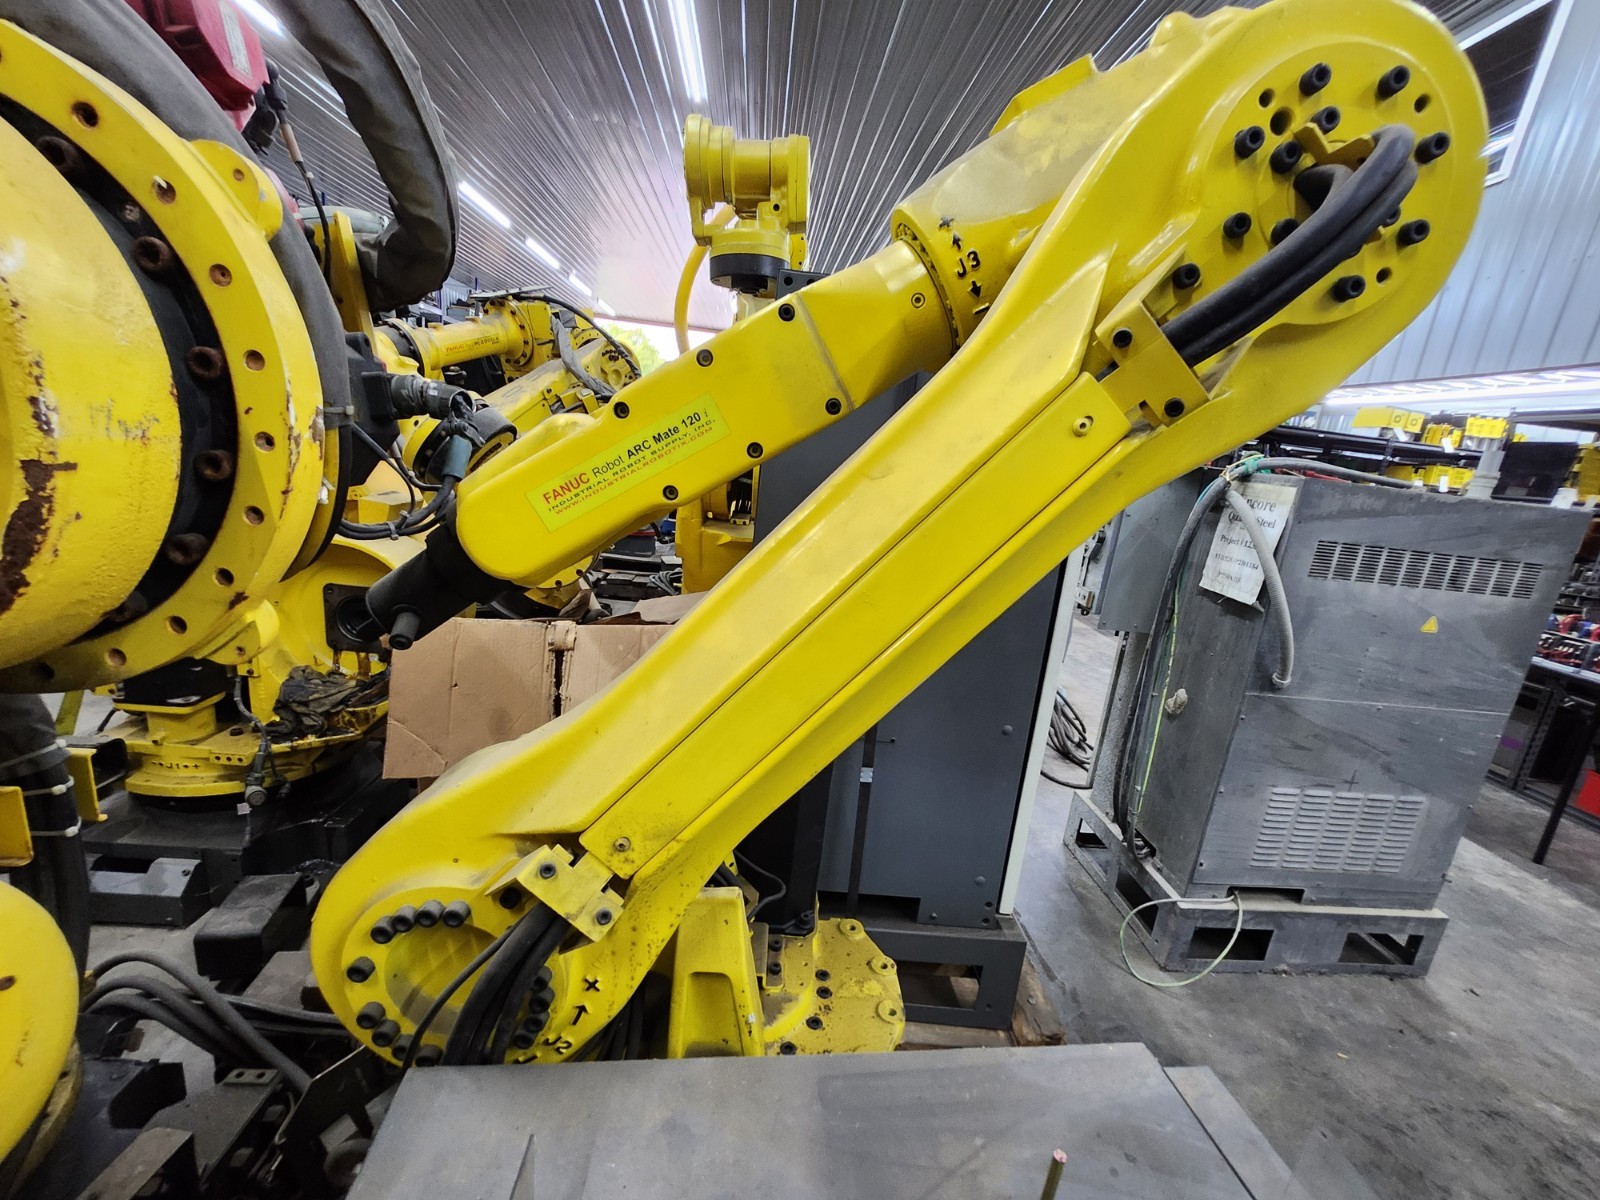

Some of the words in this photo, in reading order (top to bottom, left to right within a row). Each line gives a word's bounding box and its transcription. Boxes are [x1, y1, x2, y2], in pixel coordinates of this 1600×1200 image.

[956, 250, 981, 279] J3
[542, 472, 590, 505] FANUC
[592, 455, 625, 478] Robot
[627, 440, 651, 460] ARC
[652, 426, 680, 445] Mate
[681, 411, 701, 428] 120
[548, 477, 609, 512] INDUSTRIAL
[612, 454, 646, 477] ROBOT
[650, 433, 691, 456] SUPPLY,
[694, 419, 716, 432] INC.
[555, 427, 713, 515] WWW.INDUSTRIALROBOTIX.COM
[1245, 498, 1277, 512] ncore
[1220, 534, 1240, 546] Project
[542, 1035, 573, 1055] J2
